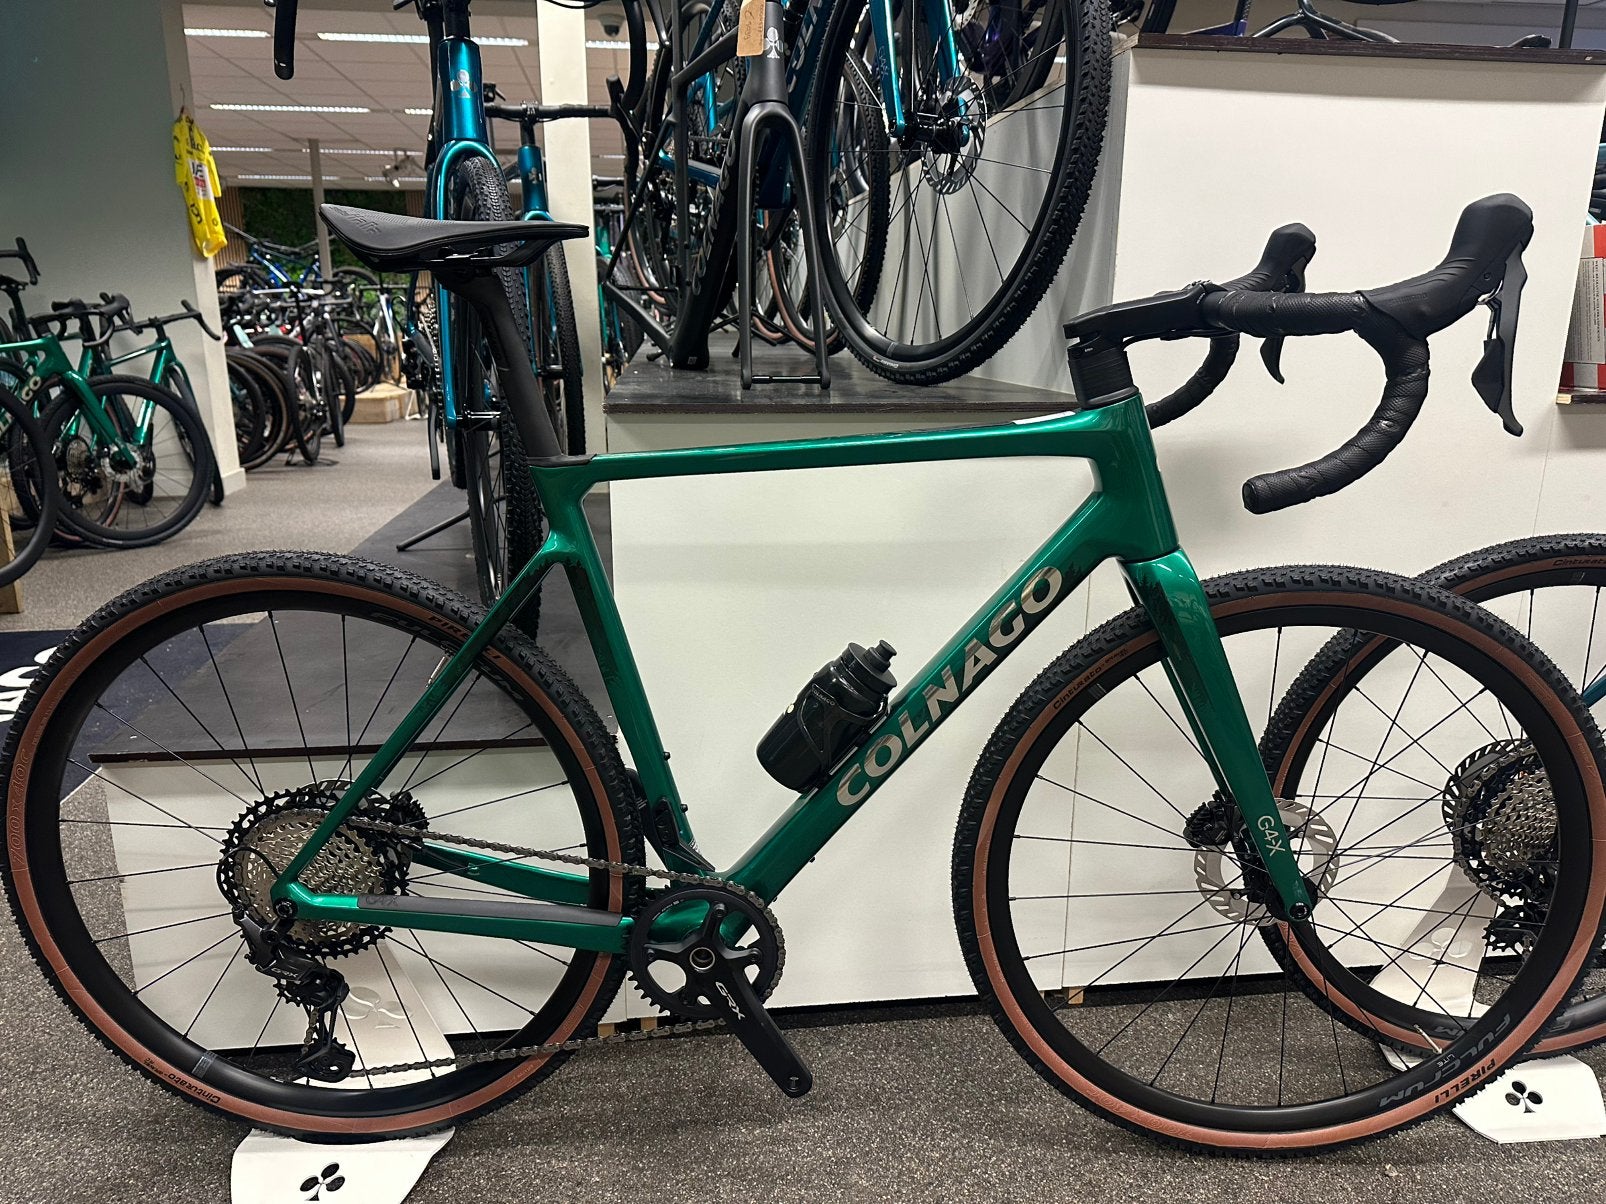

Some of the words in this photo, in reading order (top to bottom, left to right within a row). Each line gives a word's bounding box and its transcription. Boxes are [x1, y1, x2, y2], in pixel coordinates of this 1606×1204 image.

[837, 566, 1063, 806] COLNAGO
[1257, 815, 1286, 857] G4-X
[715, 981, 746, 1021] GRX
[1379, 1013, 1511, 1107] FULCRUM
[1434, 1058, 1497, 1104] PIRELLI
[1437, 1053, 1455, 1068] LITE
[167, 1072, 222, 1104] Cinturato
